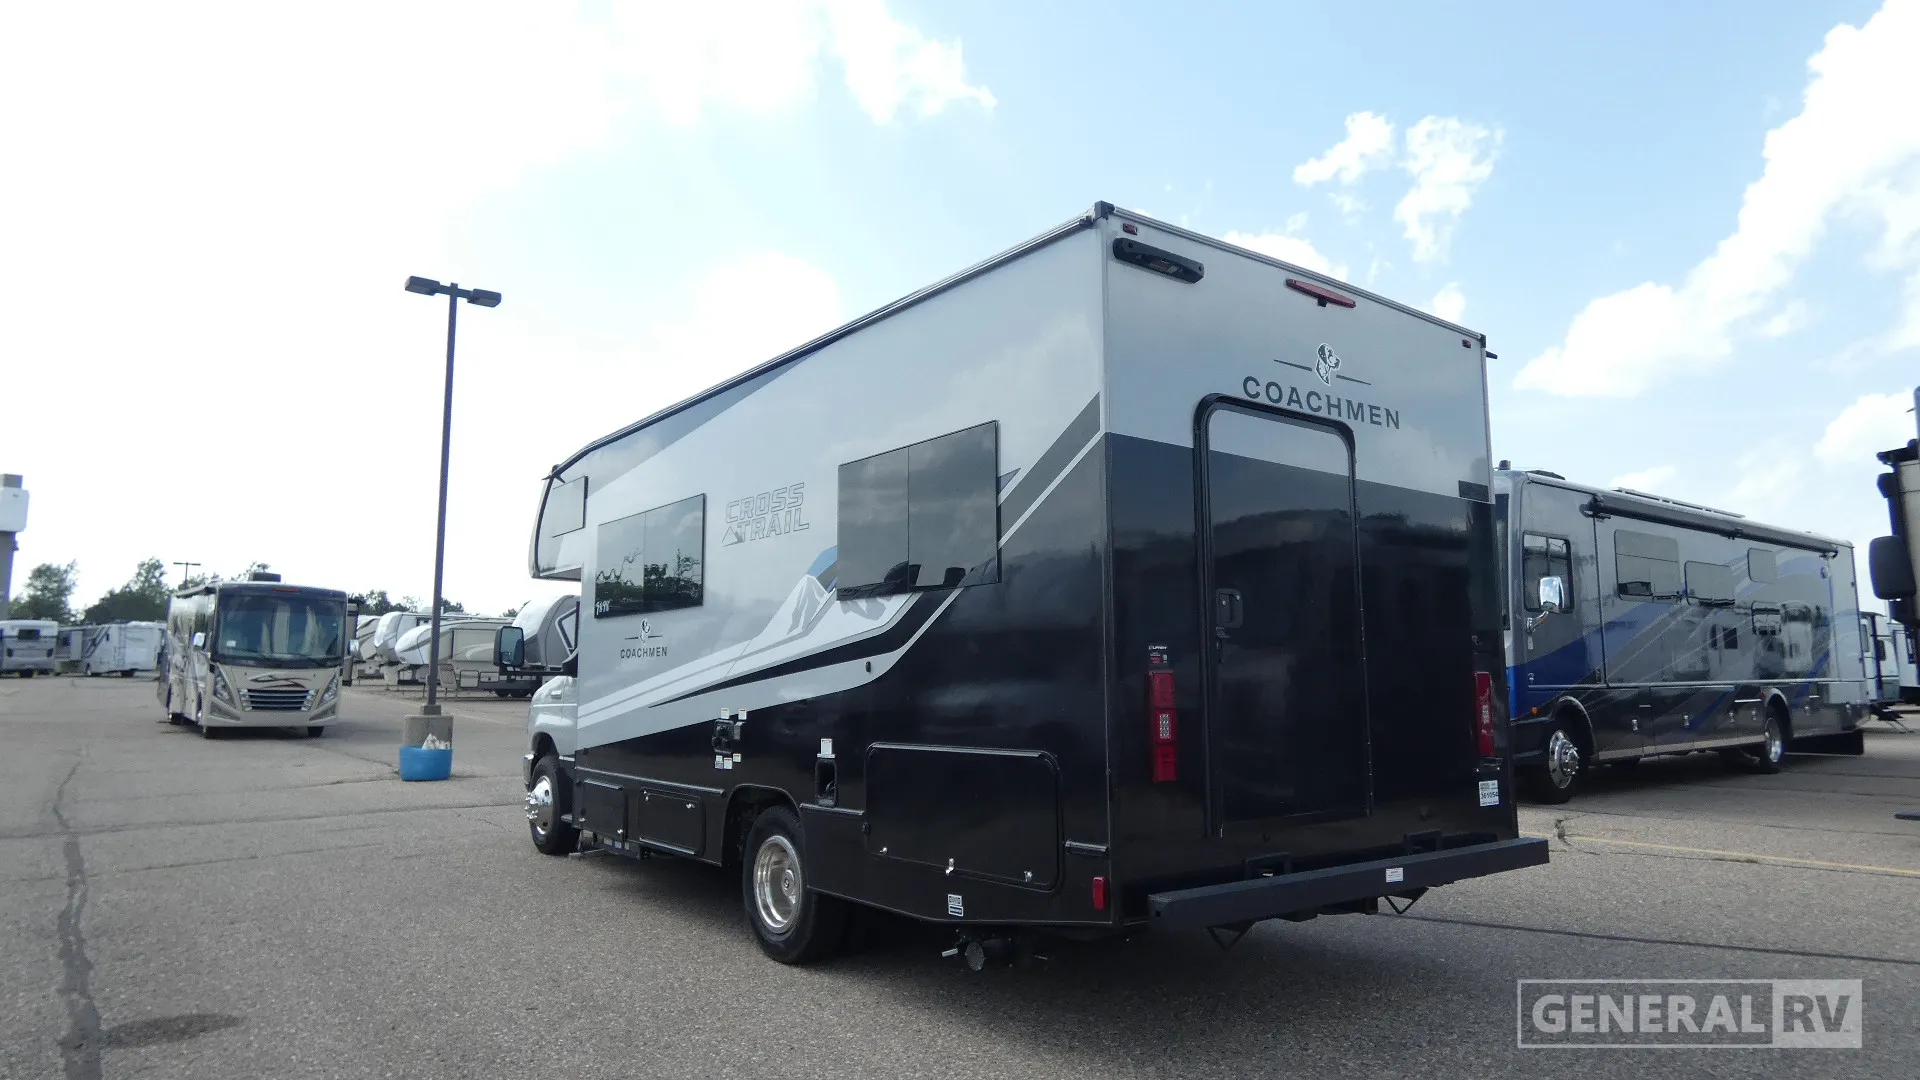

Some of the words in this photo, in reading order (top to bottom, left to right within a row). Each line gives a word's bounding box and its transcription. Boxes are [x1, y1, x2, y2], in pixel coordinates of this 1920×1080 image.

[1242, 375, 1400, 430] COACHMEN
[725, 481, 805, 524] CROSS
[736, 507, 810, 543] TRAIL
[620, 646, 668, 659] COACHMEN
